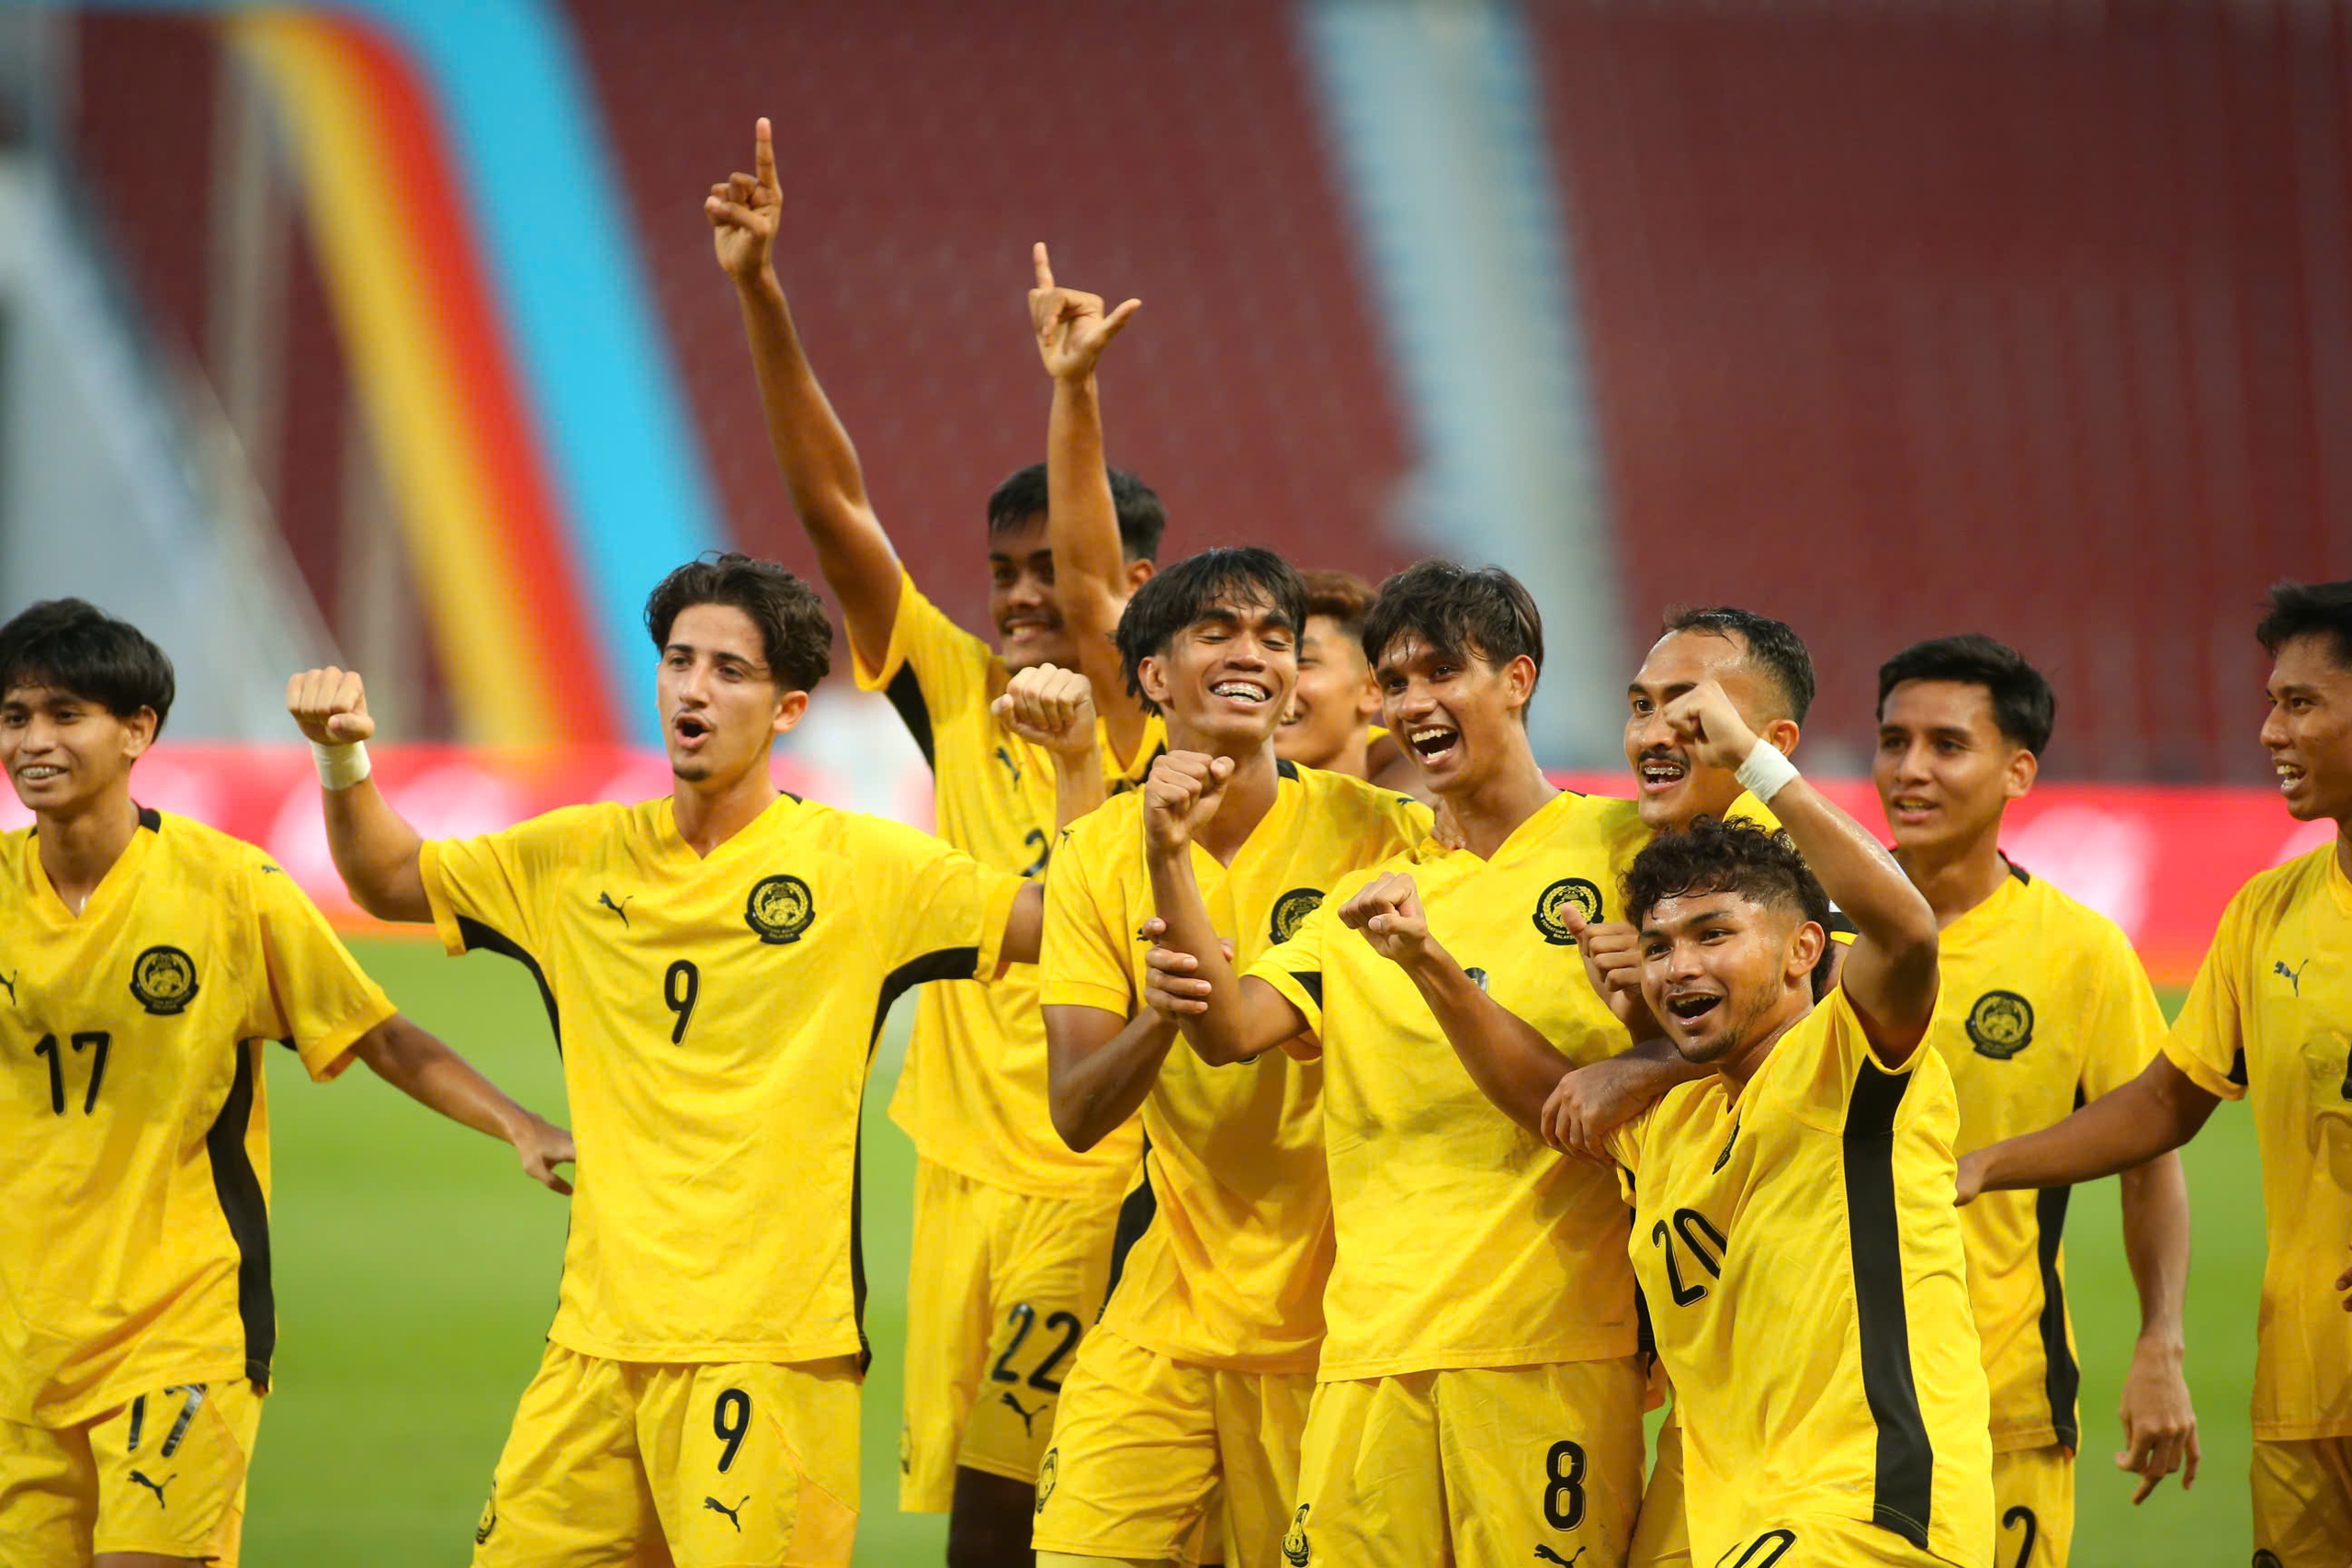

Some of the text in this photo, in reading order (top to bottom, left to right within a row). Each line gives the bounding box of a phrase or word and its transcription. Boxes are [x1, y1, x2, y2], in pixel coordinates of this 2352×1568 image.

[664, 960, 700, 1046] 9
[34, 1032, 112, 1116] 17
[1652, 1208, 1728, 1307] 20
[991, 1303, 1081, 1393] 22
[128, 1382, 208, 1458] 17
[714, 1388, 753, 1474] 9
[1544, 1440, 1587, 1532] 8
